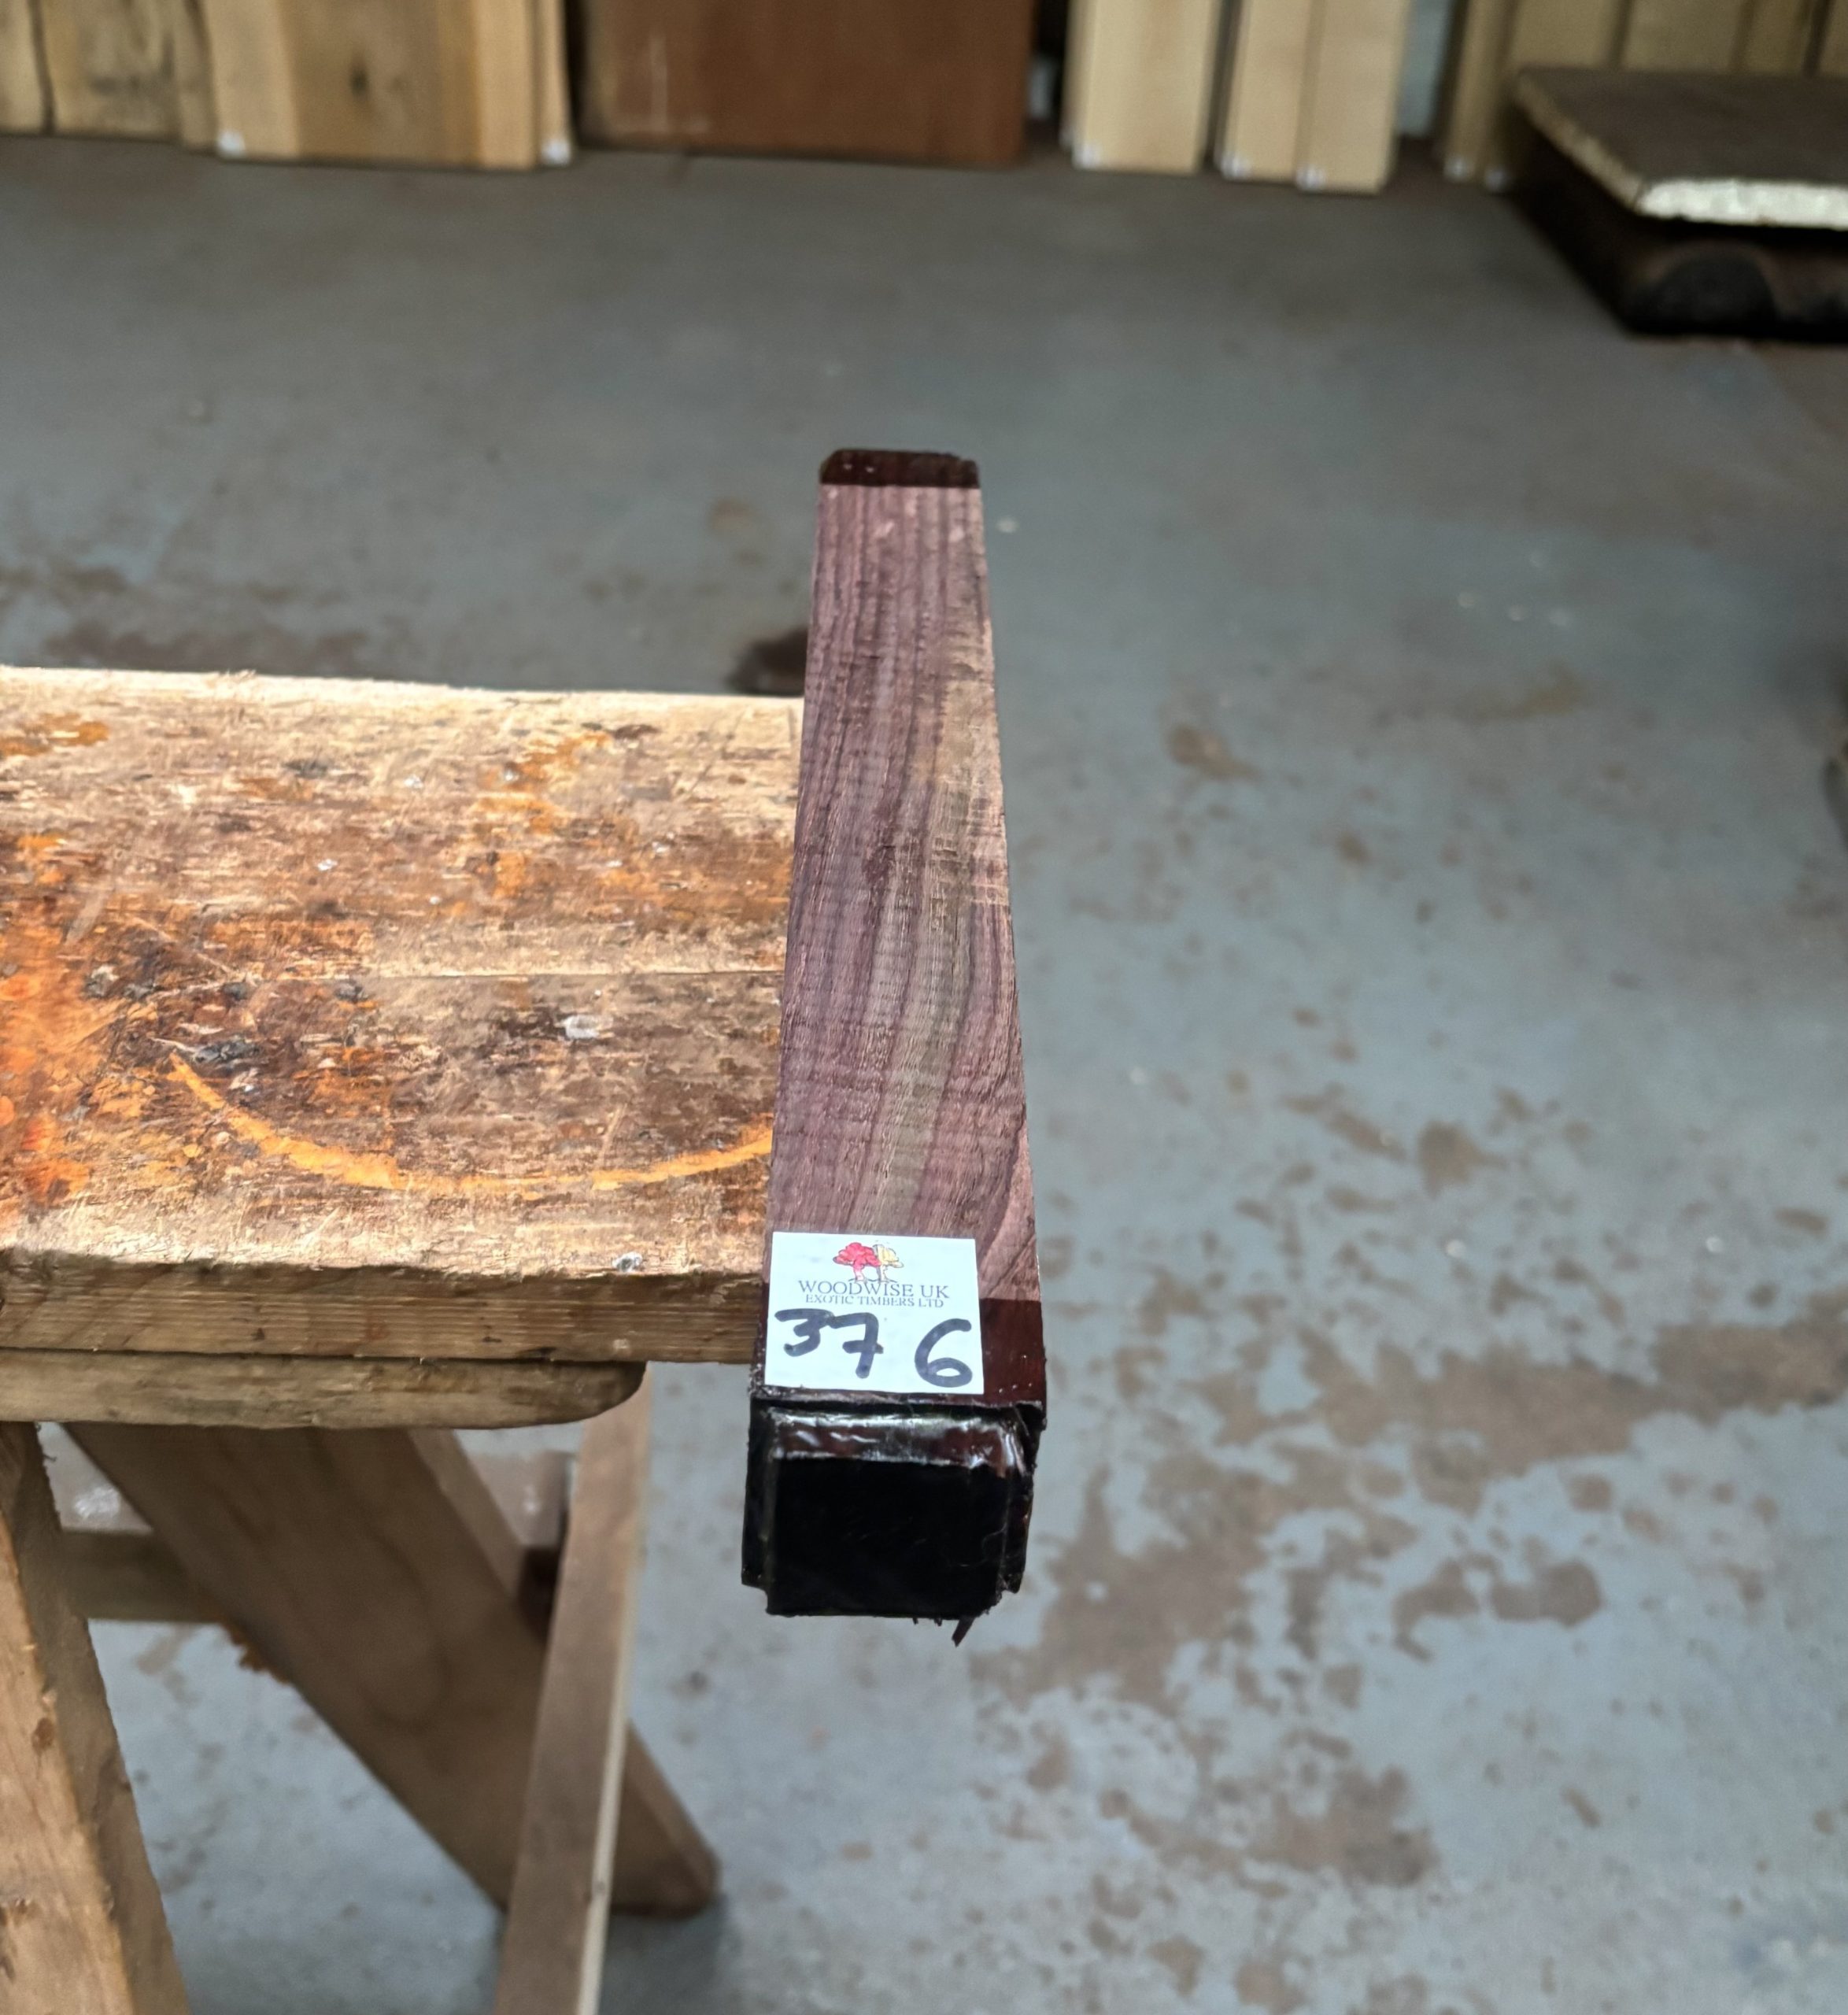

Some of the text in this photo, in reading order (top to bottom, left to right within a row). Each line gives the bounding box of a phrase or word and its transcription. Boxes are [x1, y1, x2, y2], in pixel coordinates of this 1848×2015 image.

[798, 1280, 950, 1299] WOODWISE UK
[805, 1293, 944, 1308] EXOTIC TIMBERS LTD
